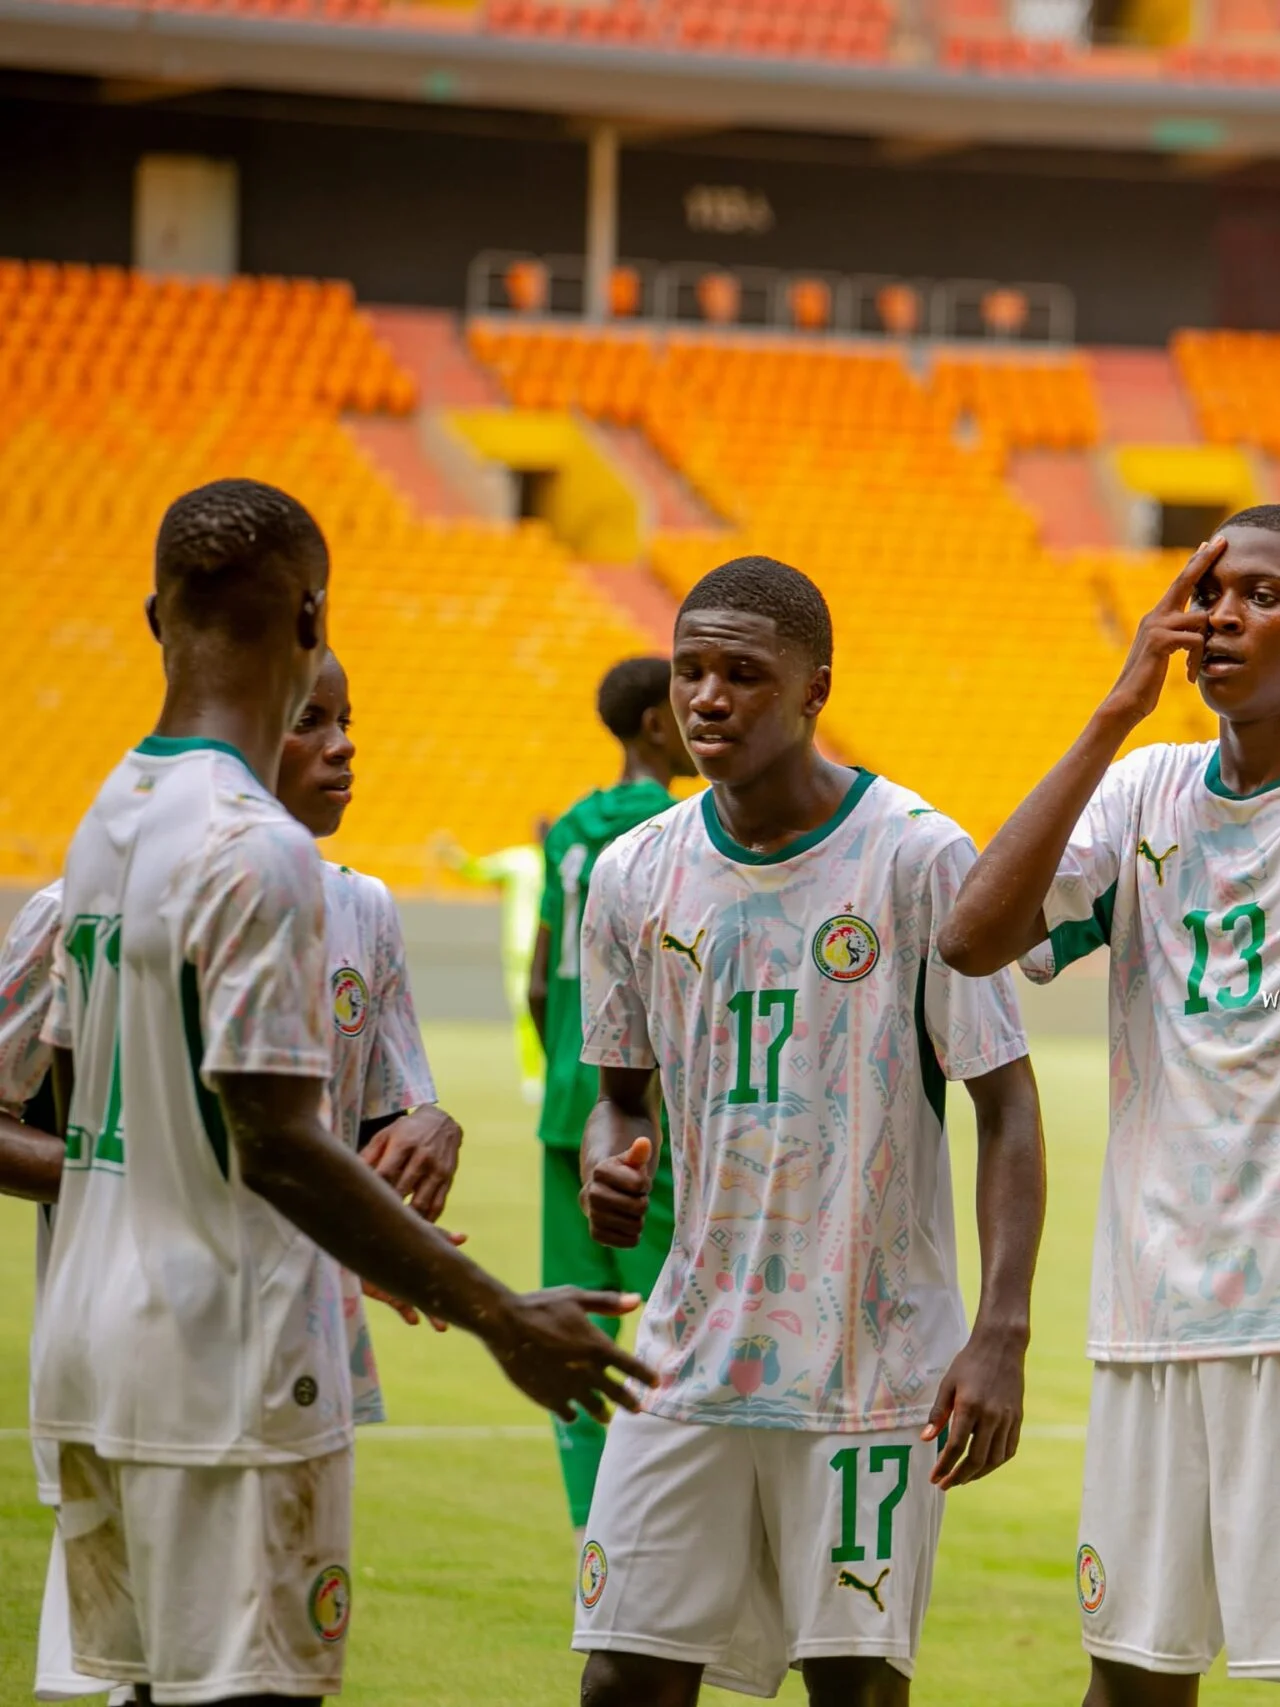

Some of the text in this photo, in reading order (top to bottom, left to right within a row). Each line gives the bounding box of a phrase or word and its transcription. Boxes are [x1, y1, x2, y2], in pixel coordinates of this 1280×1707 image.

[1183, 902, 1265, 1016] 13
[726, 988, 798, 1105] 17
[829, 1444, 913, 1563] 17
